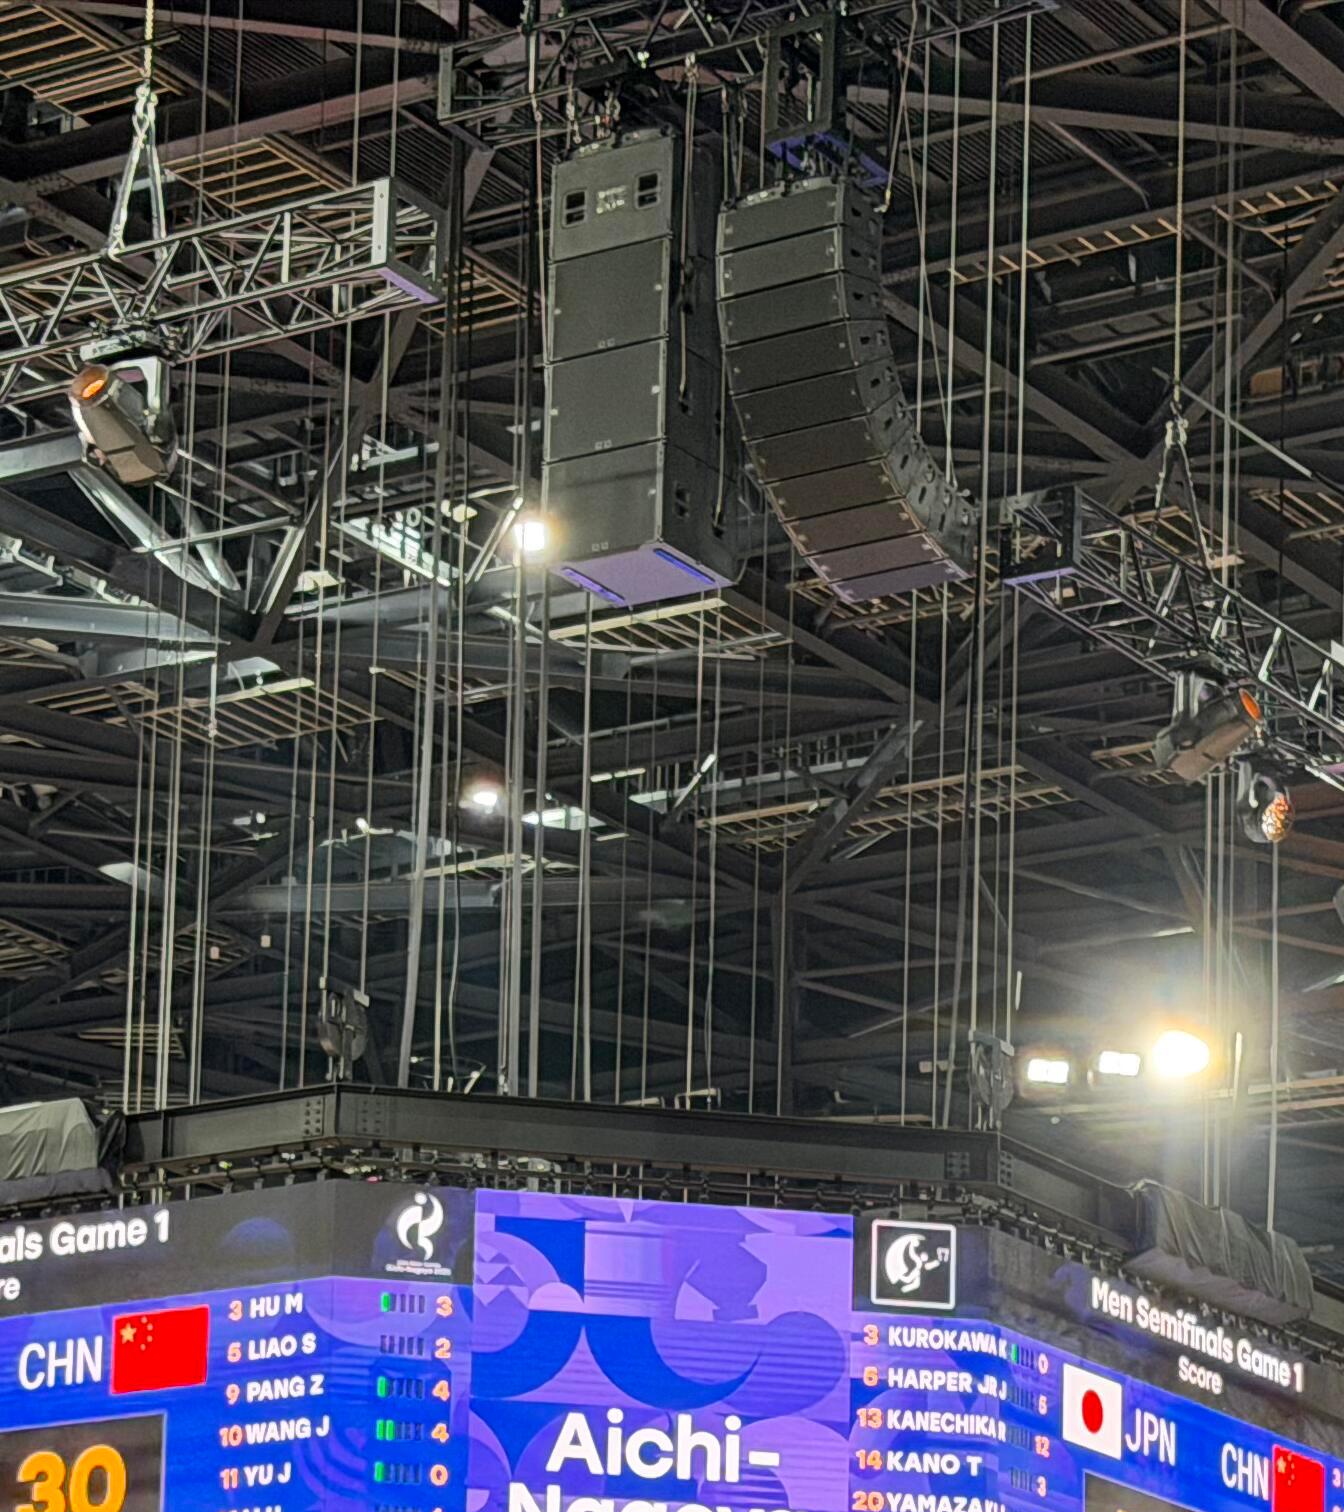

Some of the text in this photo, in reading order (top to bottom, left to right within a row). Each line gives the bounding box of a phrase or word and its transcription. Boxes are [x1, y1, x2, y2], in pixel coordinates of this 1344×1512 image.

[50, 1218, 148, 1255] Game
[154, 1212, 169, 1242] 1
[229, 1293, 303, 1321] 3 HU M
[248, 1335, 297, 1361] LIAO
[302, 1333, 316, 1355] S
[863, 1324, 997, 1356] 3 KUROKAWA
[1092, 1277, 1304, 1392] Men Semifinals Game 1
[18, 1336, 103, 1391] CHN
[1178, 1355, 1223, 1394] Score
[226, 1375, 325, 1405] 9 PANG Z
[888, 1368, 972, 1392] HARPER
[220, 1416, 330, 1447] 10 WANG J
[856, 1408, 997, 1438] 13 KANECHIKA
[546, 1408, 780, 1482] Aichi-
[1125, 1408, 1268, 1501] JPN CHN
[220, 1462, 291, 1489] 11 YU J
[856, 1449, 983, 1476] 14 KANO T
[853, 1491, 884, 1512] 20
